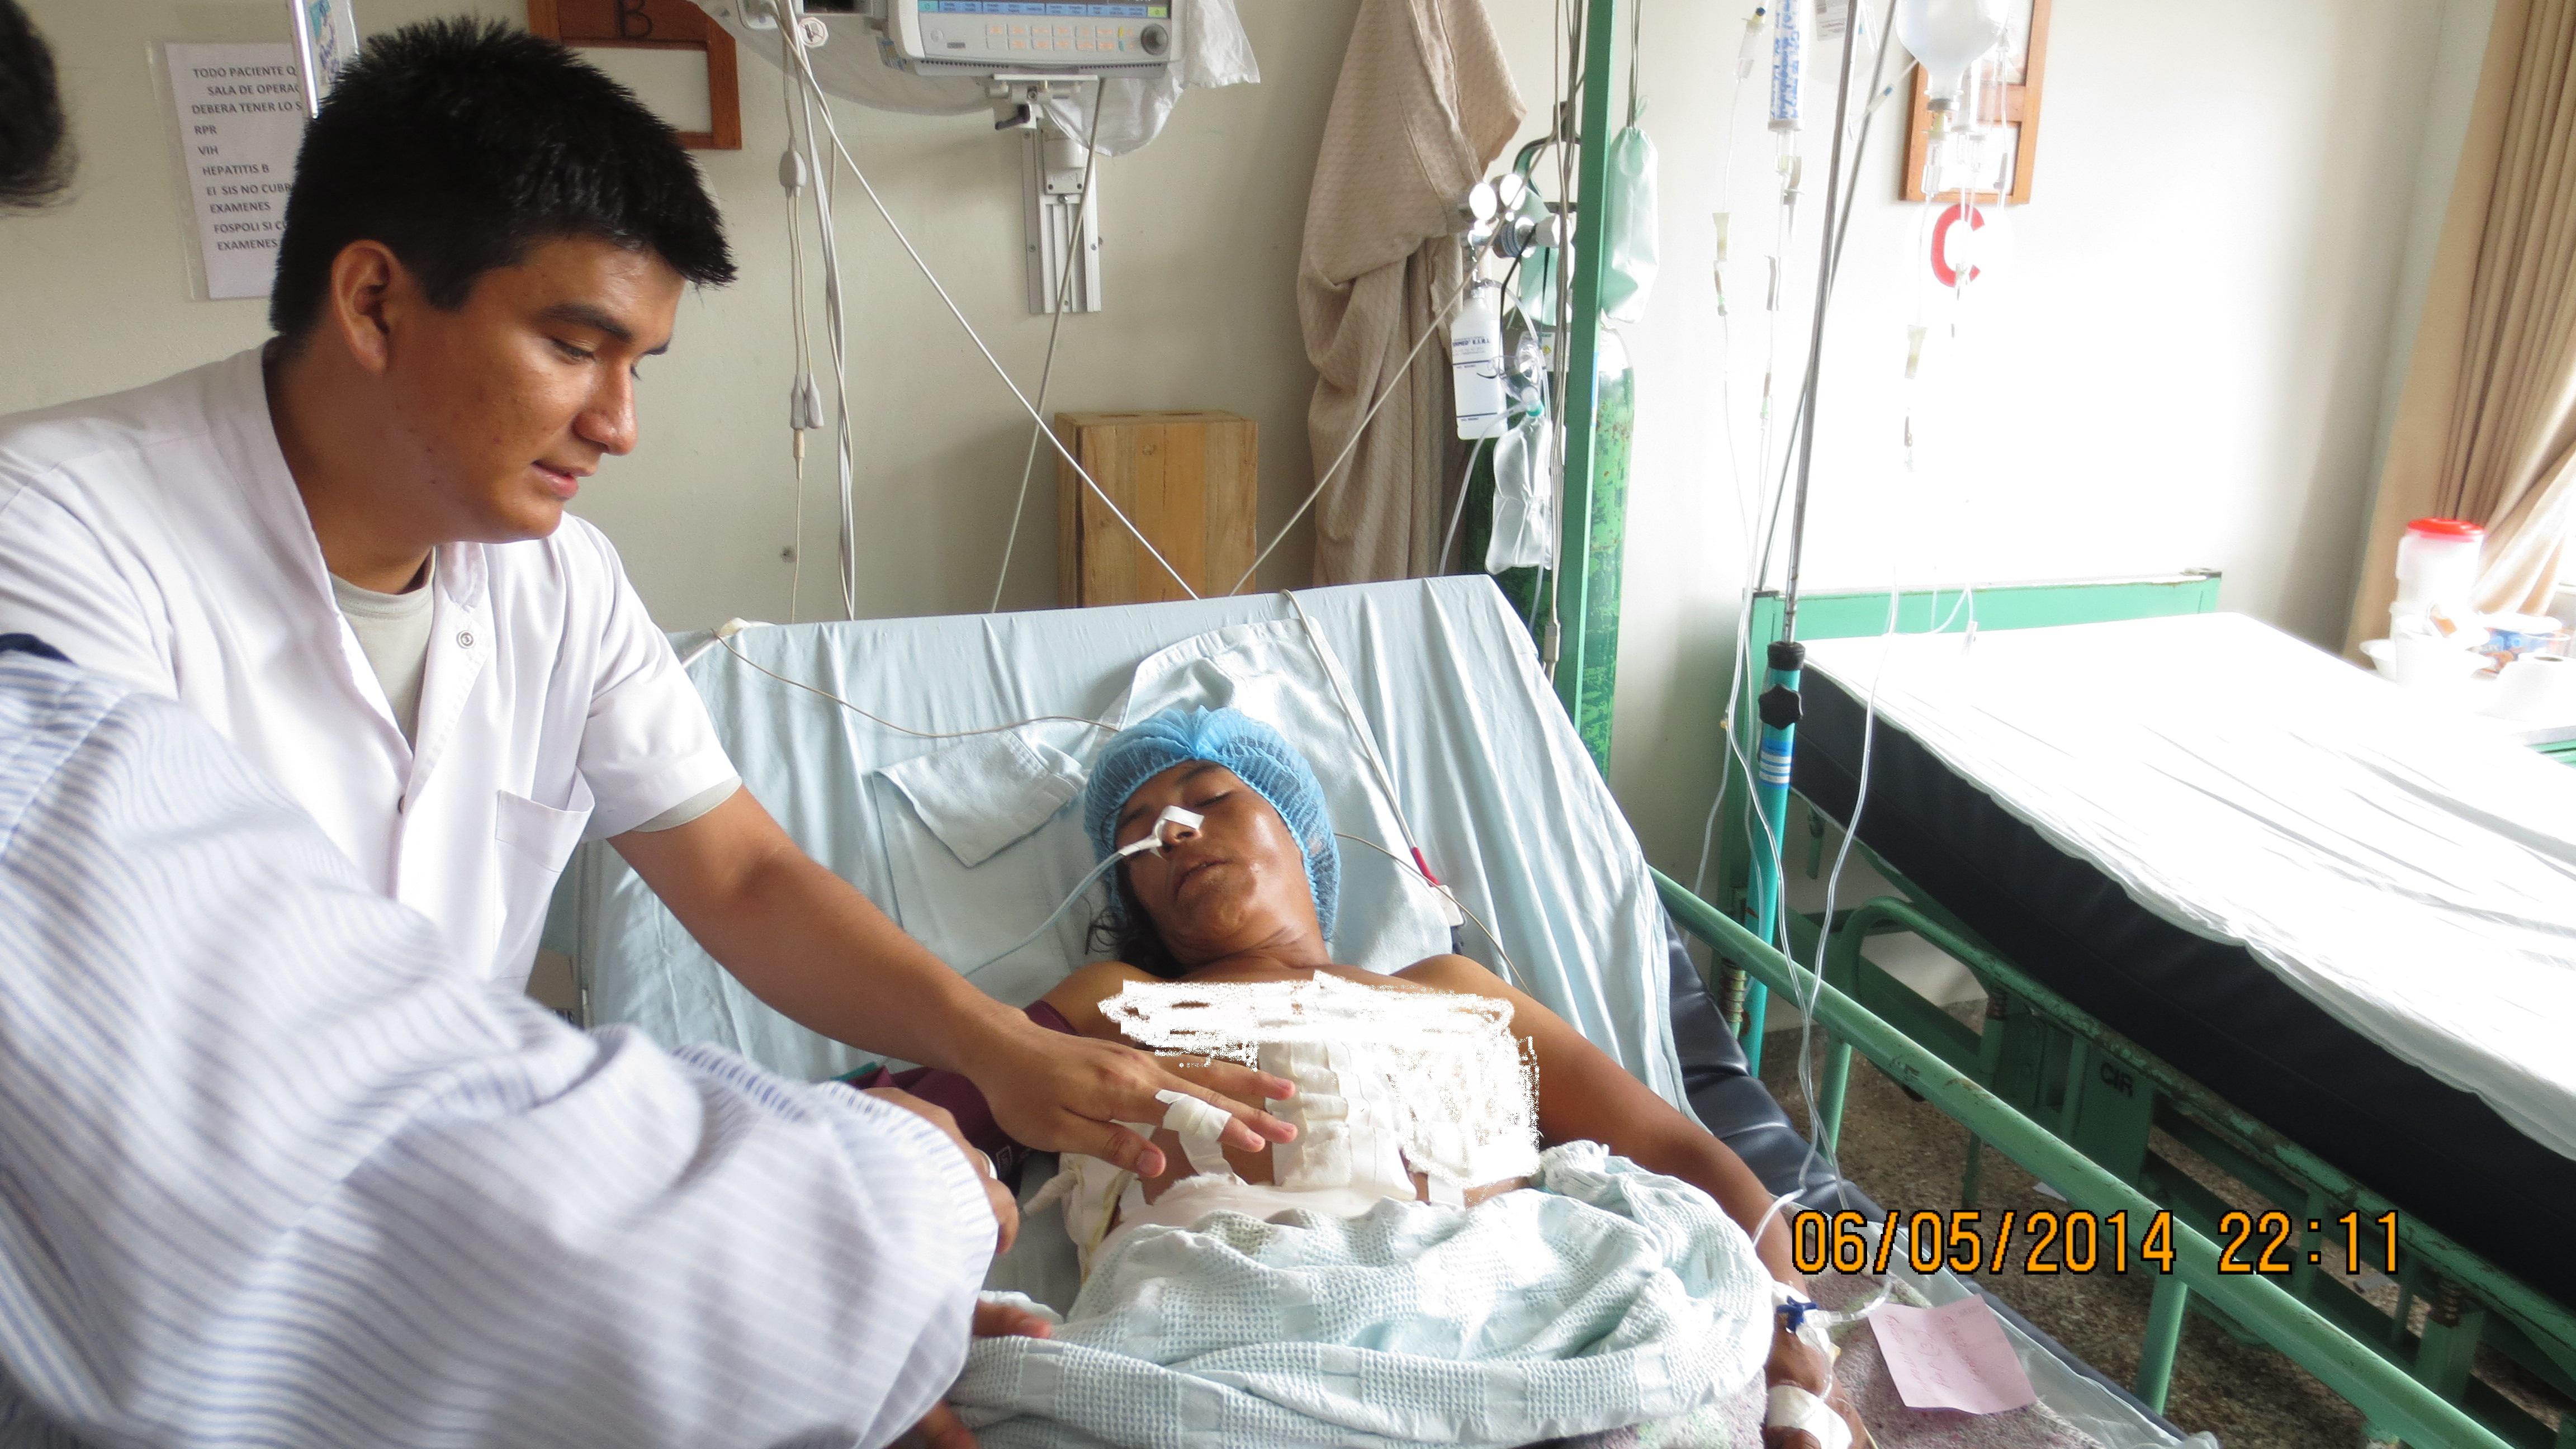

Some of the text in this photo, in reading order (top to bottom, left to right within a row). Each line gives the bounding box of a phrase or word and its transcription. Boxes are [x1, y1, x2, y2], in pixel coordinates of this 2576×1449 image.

[617, 0, 653, 40] B
[193, 67, 226, 78] TODO
[229, 66, 283, 77] PACIENTE
[207, 86, 236, 95] SALA
[239, 84, 253, 94] DE
[192, 103, 237, 113] DEBERA
[239, 102, 275, 112] TENER
[278, 102, 292, 111] LO
[194, 125, 217, 134] RPR
[198, 146, 219, 155] VIH
[202, 164, 270, 176] HEPATITIS B
[222, 186, 238, 195] SIS
[241, 184, 258, 194] NO
[210, 202, 271, 214] EXAMENES
[214, 222, 259, 233] FOSPOLI
[262, 222, 272, 230] SI
[217, 239, 278, 250] EXAMENES
[1931, 203, 1985, 287] C
